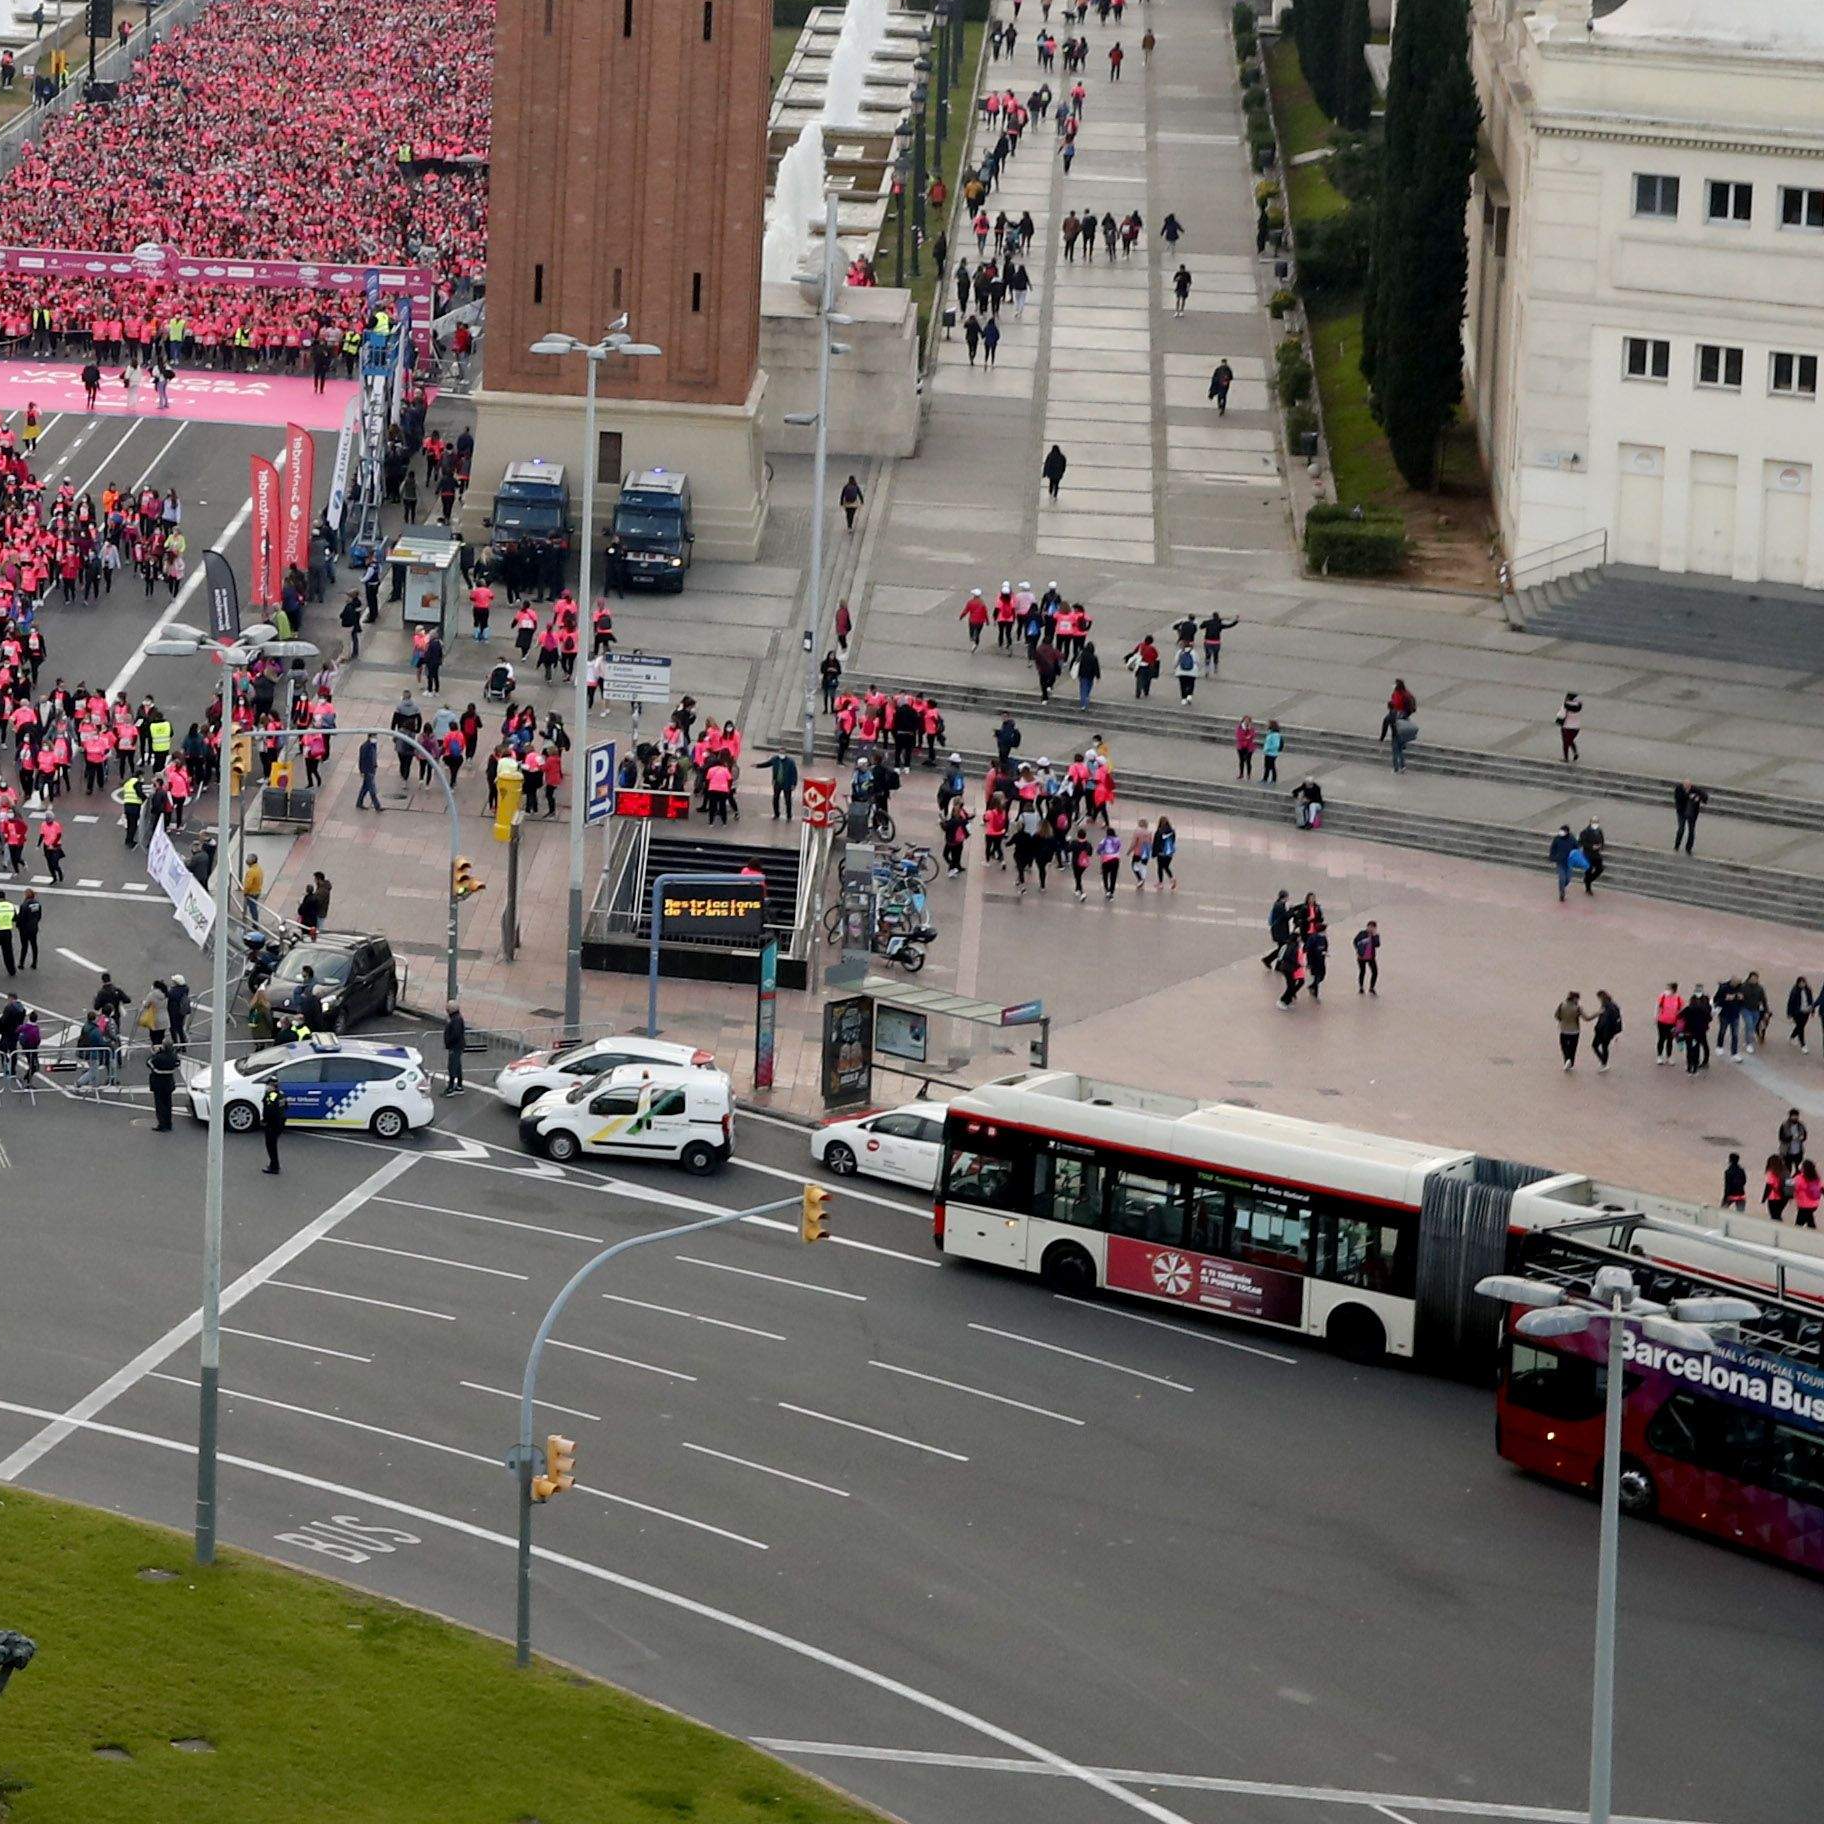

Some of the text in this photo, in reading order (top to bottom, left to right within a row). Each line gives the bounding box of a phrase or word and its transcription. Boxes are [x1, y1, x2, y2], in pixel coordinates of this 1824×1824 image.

[589, 749, 609, 802] P
[663, 898, 762, 909] Restriccions
[663, 908, 681, 917] de
[1209, 1277, 1236, 1291] PUEDE
[1236, 1282, 1263, 1296] TOCAR
[1621, 1329, 1824, 1422] Barcelona Bus
[1747, 1355, 1794, 1380] OFFICIAL
[273, 1514, 422, 1565] BUS
